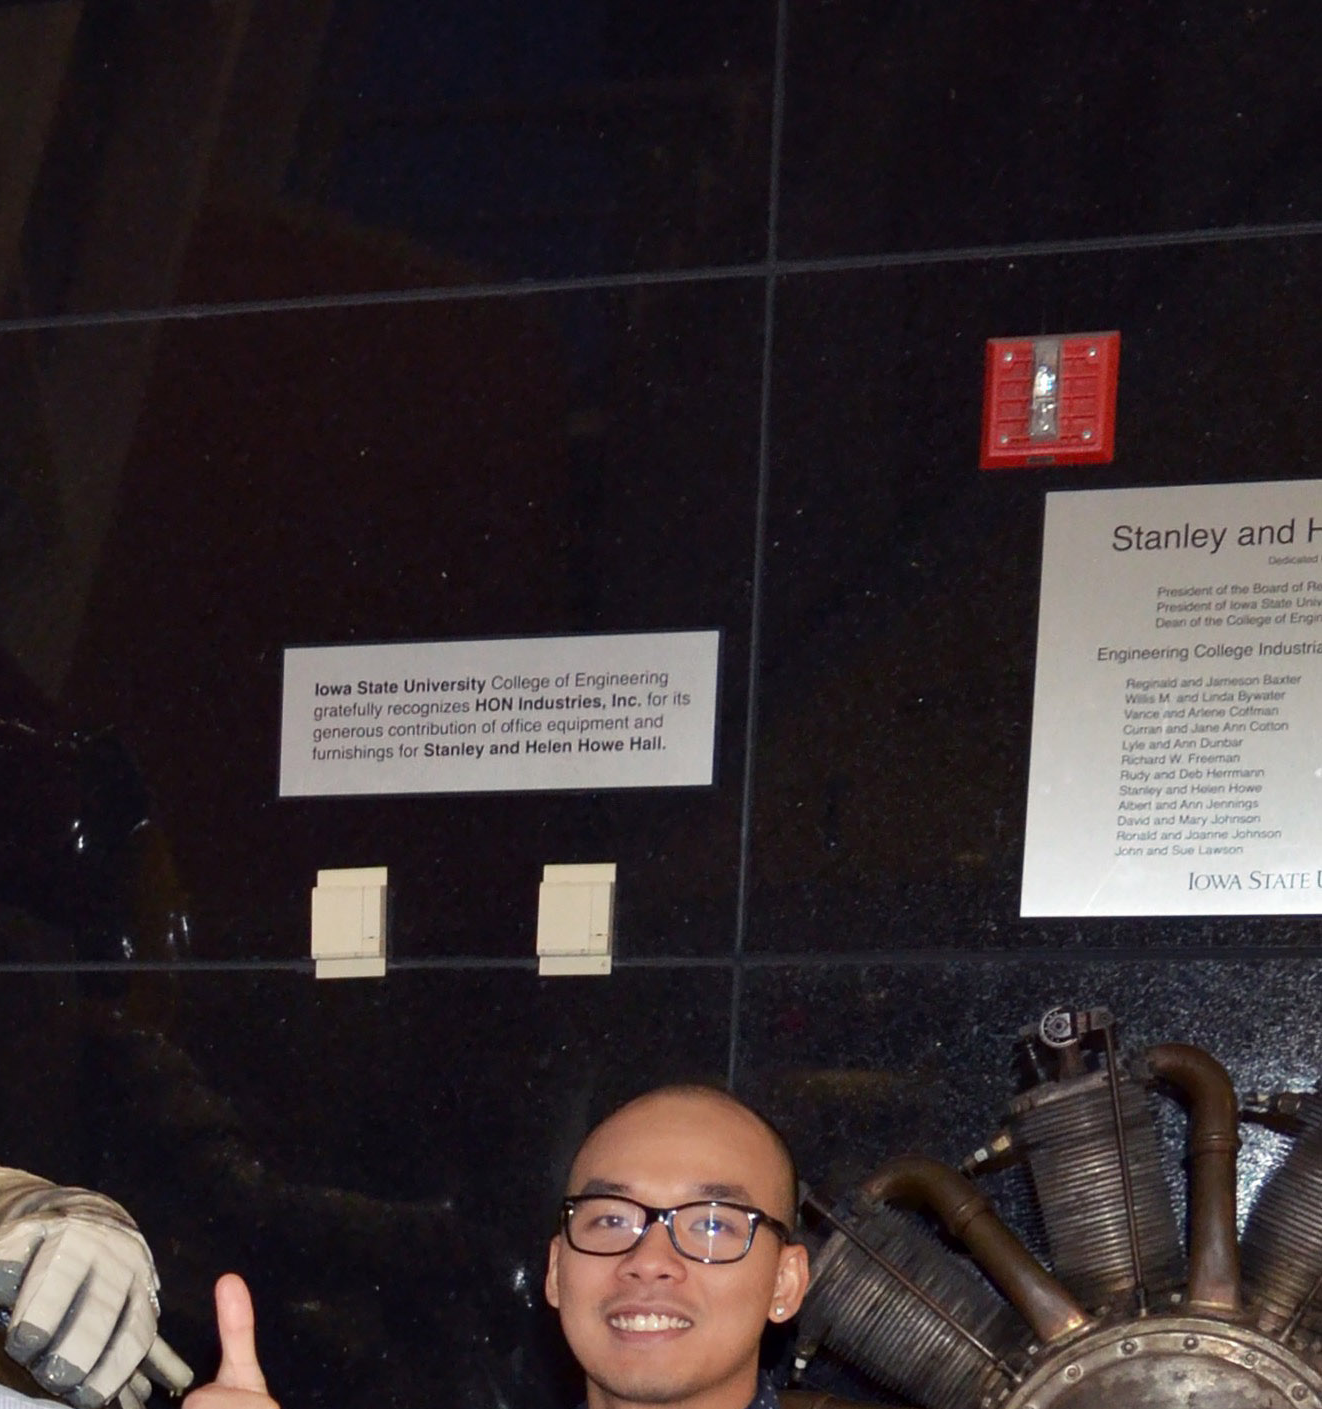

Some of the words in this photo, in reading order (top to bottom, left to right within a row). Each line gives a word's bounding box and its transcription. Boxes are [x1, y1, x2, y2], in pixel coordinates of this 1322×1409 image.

[1113, 523, 1227, 554] Stanley
[1238, 518, 1295, 546] and
[1158, 586, 1212, 596] President
[1216, 585, 1228, 594] of
[1231, 585, 1249, 594] the
[1253, 583, 1288, 593] Board
[1292, 582, 1303, 591] of
[1157, 601, 1211, 612] President
[1215, 600, 1226, 609] of
[1230, 599, 1257, 609] Iowa
[1261, 598, 1292, 608] State
[1156, 617, 1186, 628] Dean
[1190, 617, 1201, 626] of
[1205, 616, 1222, 626] the
[1227, 614, 1271, 627] College
[1275, 614, 1286, 623] of
[1097, 645, 1189, 664] Engineering
[1195, 643, 1253, 660] College
[315, 683, 352, 696] Iowa
[357, 681, 398, 694] State
[404, 677, 486, 694] University
[492, 675, 550, 692] College
[556, 674, 570, 688] of
[575, 672, 669, 690] Engineering
[1126, 678, 1177, 691] Reginald
[1181, 678, 1203, 687] and
[1207, 677, 1259, 687] Jameson
[1264, 675, 1301, 685] Baxter
[1177, 693, 1198, 702] and
[1203, 692, 1234, 701] Linda
[1238, 690, 1286, 702] Bywater
[314, 702, 383, 721] gratefully
[388, 701, 470, 717] recognizes
[476, 697, 513, 712] HON
[519, 695, 606, 710] Industries,
[612, 694, 641, 707] Inc.
[648, 692, 668, 706] for
[673, 692, 691, 705] its
[1124, 709, 1159, 719] Vance
[1163, 709, 1185, 717] and
[1188, 707, 1225, 717] Arlene
[313, 725, 383, 742] generous
[388, 721, 476, 737] contribution
[482, 720, 497, 733] of
[501, 718, 542, 733] office
[547, 716, 629, 734] equipment
[634, 714, 664, 729] and
[1123, 725, 1162, 735] Curran
[1166, 724, 1188, 733] and
[1192, 723, 1219, 732] Jane
[1223, 722, 1246, 731] Ann
[1250, 721, 1289, 731] Cotton
[313, 746, 394, 762] furnishings
[400, 744, 419, 757] for
[424, 743, 484, 759] Stanley
[490, 741, 520, 754] and
[526, 740, 572, 754] Helen
[578, 738, 624, 752] Howe
[630, 736, 666, 750] Hall.
[1123, 741, 1145, 752] Lyle
[1149, 740, 1170, 749] and
[1174, 739, 1196, 748] Ann
[1200, 738, 1243, 748] Dunbar
[1122, 754, 1165, 765] Richard
[1189, 753, 1240, 763] Freeman
[1121, 770, 1150, 782] Rudy
[1154, 770, 1175, 779] and
[1180, 769, 1203, 778] Deb
[1119, 785, 1162, 797] Stanley
[1166, 785, 1187, 794] and
[1191, 784, 1225, 793] Helen
[1229, 783, 1262, 792] Howe
[1118, 800, 1152, 810] Albert
[1156, 800, 1177, 809] and
[1180, 799, 1203, 809] Ann
[1207, 798, 1259, 810] Jennings
[1117, 816, 1150, 826] David
[1154, 815, 1175, 824] and
[1179, 815, 1208, 826] Mary
[1212, 814, 1261, 824] Johnson
[1117, 830, 1157, 840] Ronald
[1161, 830, 1181, 839] and
[1186, 830, 1228, 840] Joanne
[1232, 829, 1282, 839] Johnson
[1115, 846, 1143, 856] John
[1147, 846, 1168, 855] and
[1172, 845, 1194, 854] Sue
[1199, 845, 1243, 854] Lawson
[1188, 872, 1242, 890] IOWA
[1249, 871, 1310, 889] STATE
